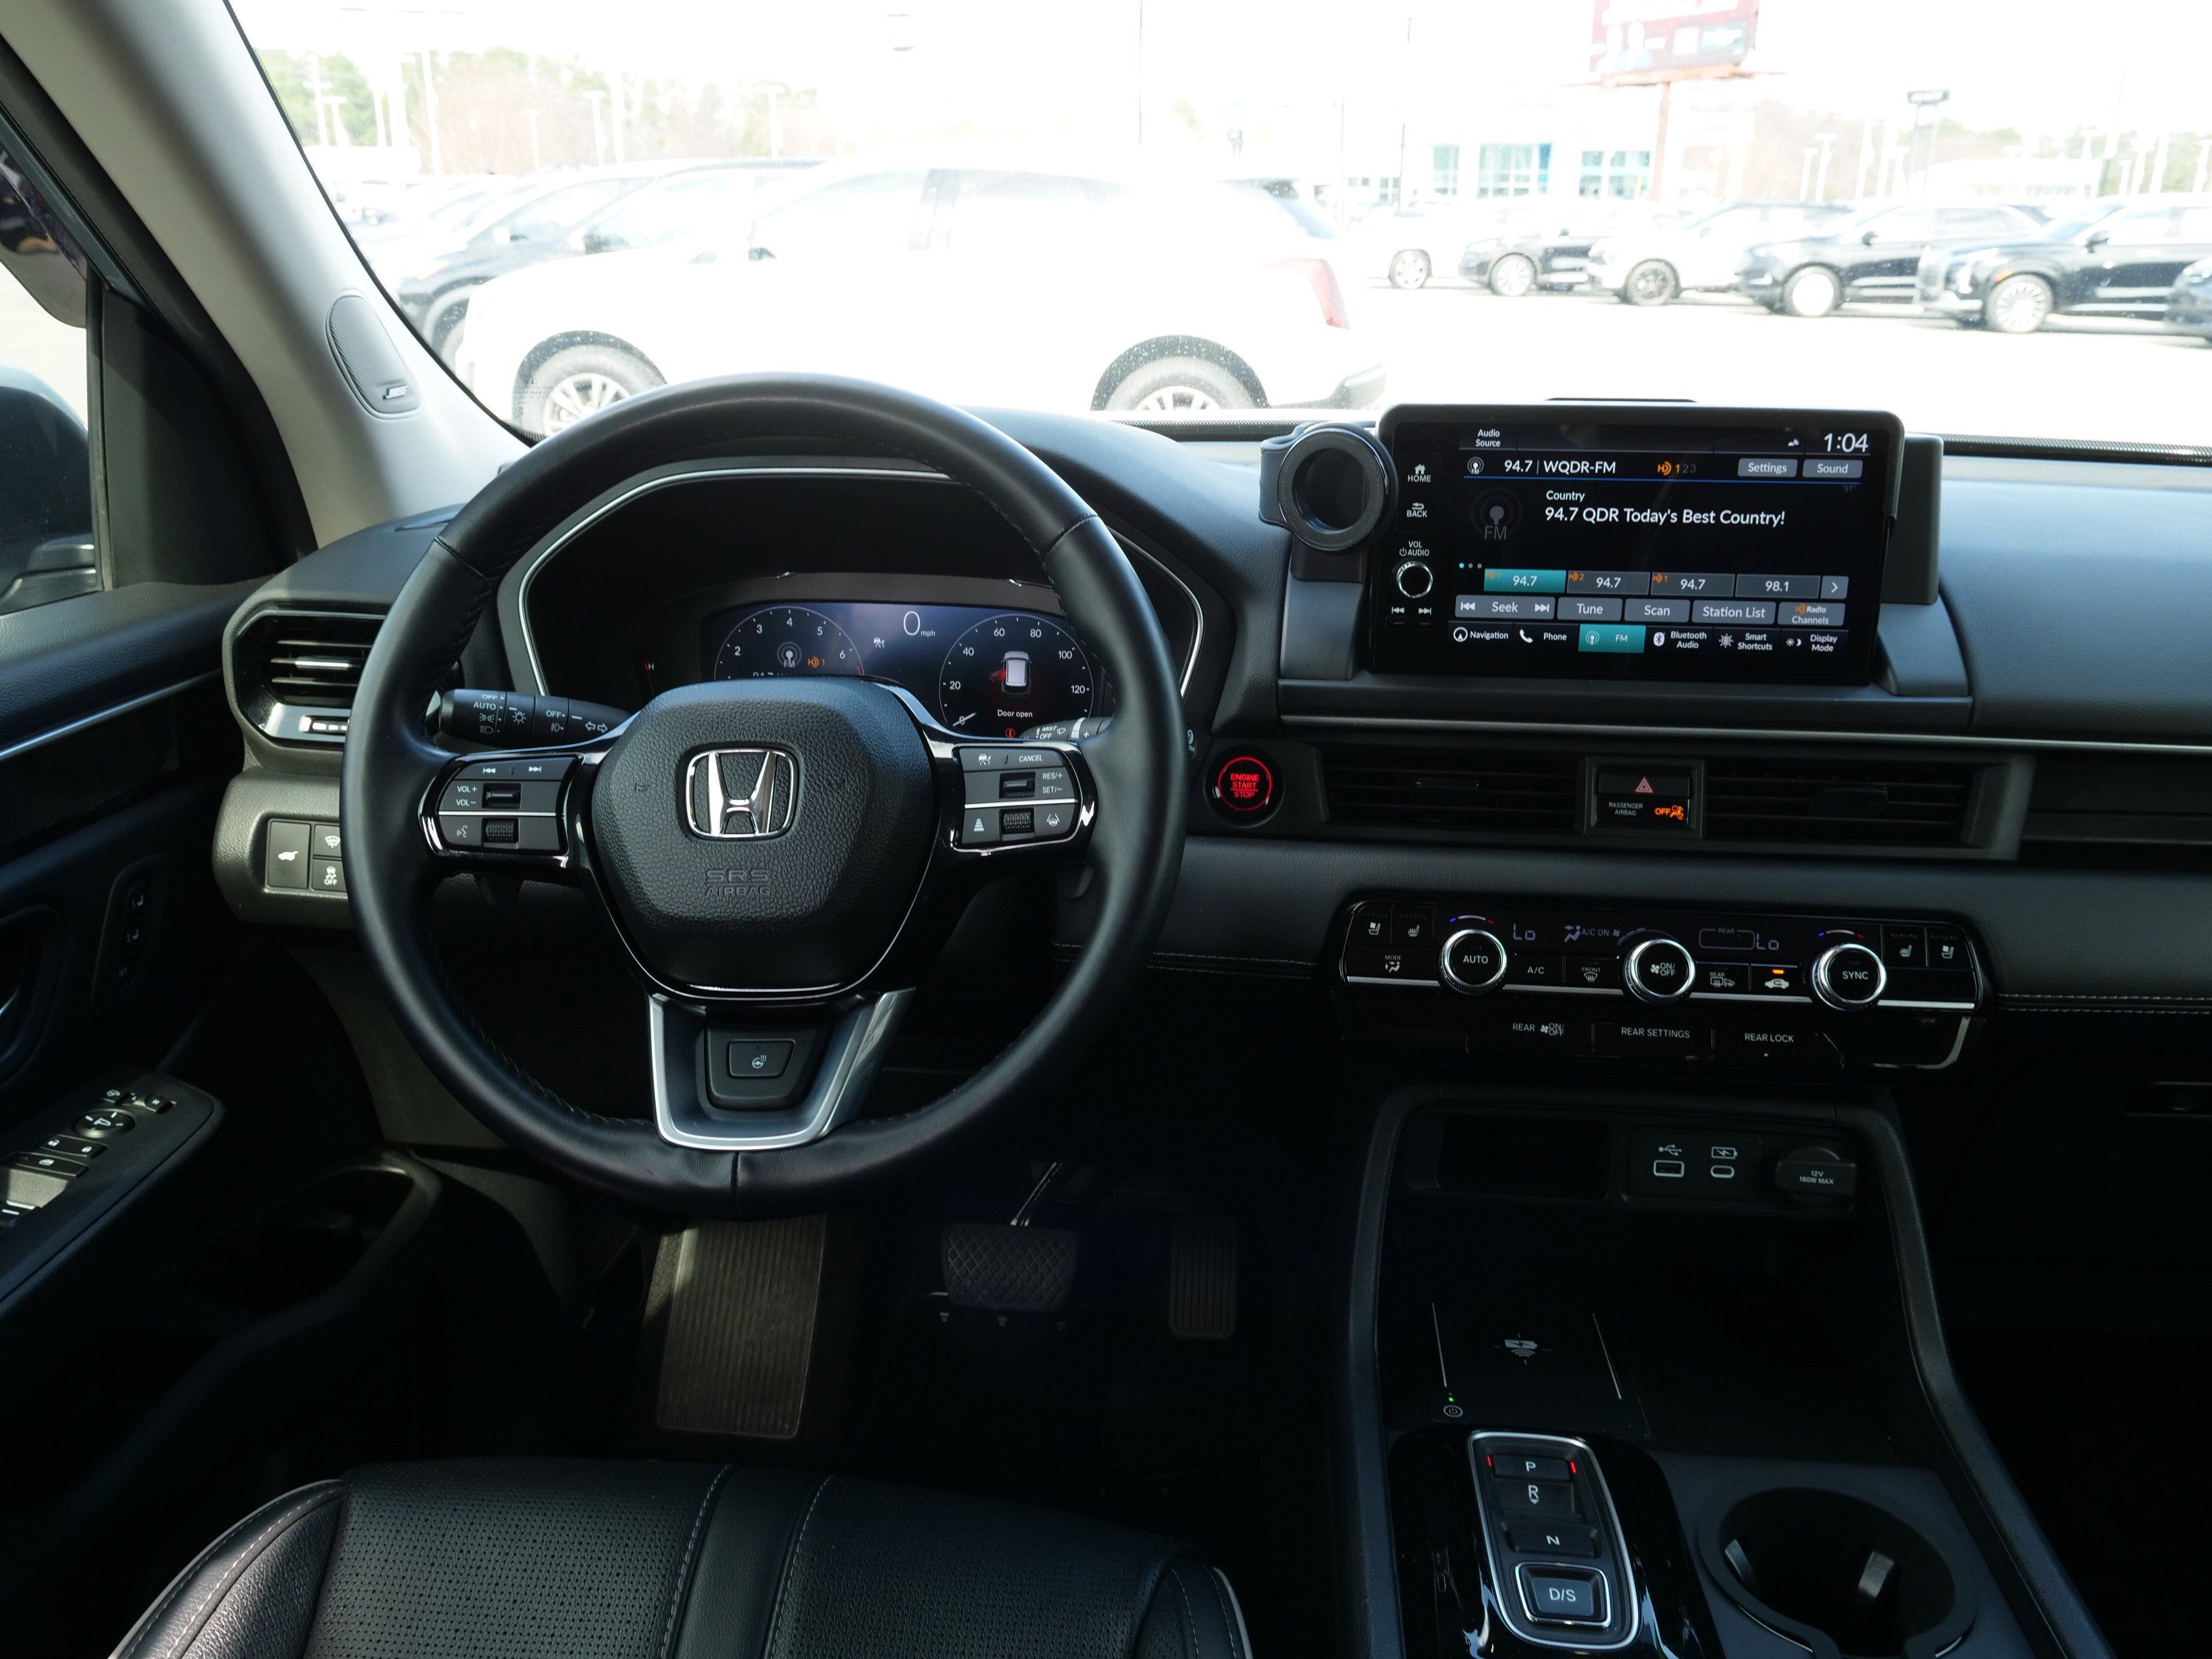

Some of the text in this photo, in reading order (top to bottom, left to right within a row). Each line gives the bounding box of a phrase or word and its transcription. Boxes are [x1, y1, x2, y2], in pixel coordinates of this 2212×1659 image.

[1478, 429, 1500, 437] Audio
[1824, 433, 1869, 453] 1:04
[1505, 460, 1616, 474] 94.7 WQDR-FM
[1748, 462, 1787, 474] Settings
[1817, 464, 1848, 474] Sound
[1546, 490, 1585, 502] Country
[1407, 509, 1427, 518] BACK
[1545, 507, 1785, 527] 94.7 QDR Today's Best Country!
[1484, 526, 1507, 540] FM
[1408, 548, 1430, 557] AUDIO
[1513, 576, 1537, 587] 94.7
[1596, 577, 1621, 589] 94.7
[1680, 579, 1705, 591] 94.7
[1766, 580, 1790, 592] 98.1
[1492, 601, 1518, 613] Seek
[1577, 604, 1604, 614] Tune
[1644, 605, 1670, 616] Scan
[1807, 605, 1826, 614] Radio
[1703, 607, 1766, 619] Station List
[787, 617, 793, 626] 4
[903, 610, 921, 636] 0
[1792, 616, 1829, 625] Channels
[756, 624, 763, 634] 3
[817, 626, 823, 636] 5
[994, 628, 1005, 637] 60
[1030, 629, 1042, 638] 80
[1470, 631, 1508, 641] Navigation
[1543, 632, 1567, 641] Phone
[1670, 631, 1707, 639] Bluetooth
[1745, 633, 1767, 642] Smart
[1810, 635, 1838, 644] Display
[1676, 641, 1699, 649] Audio
[1738, 642, 1772, 651] Shortcuts
[1812, 644, 1834, 652] Mode
[734, 646, 741, 656] 2
[839, 650, 846, 660] 6
[962, 647, 974, 656] 40
[1058, 650, 1072, 660] 100
[784, 660, 795, 669] FM
[950, 681, 961, 690] 20
[1071, 685, 1085, 694] 120
[473, 702, 496, 711] AUTO
[998, 709, 1015, 717] Door
[1230, 773, 1260, 781] ENGINE
[1608, 801, 1644, 810] PASSENGER
[1655, 807, 1671, 816] OFF
[706, 869, 770, 884] SRS
[705, 886, 771, 896] AIRBAG
[1582, 928, 1595, 937] A/C
[1463, 955, 1489, 964] AUTO
[1527, 966, 1545, 975] A/C
[1842, 970, 1869, 980] SYNC
[1512, 1023, 1536, 1033] REAR
[1621, 1027, 1690, 1039] REAR SETTINGS
[1744, 1033, 1794, 1043] REAR LOCK
[1526, 1461, 1537, 1472] P
[1528, 1484, 1539, 1500] R
[1546, 1535, 1561, 1546] N
[1549, 1586, 1577, 1603] D/S
